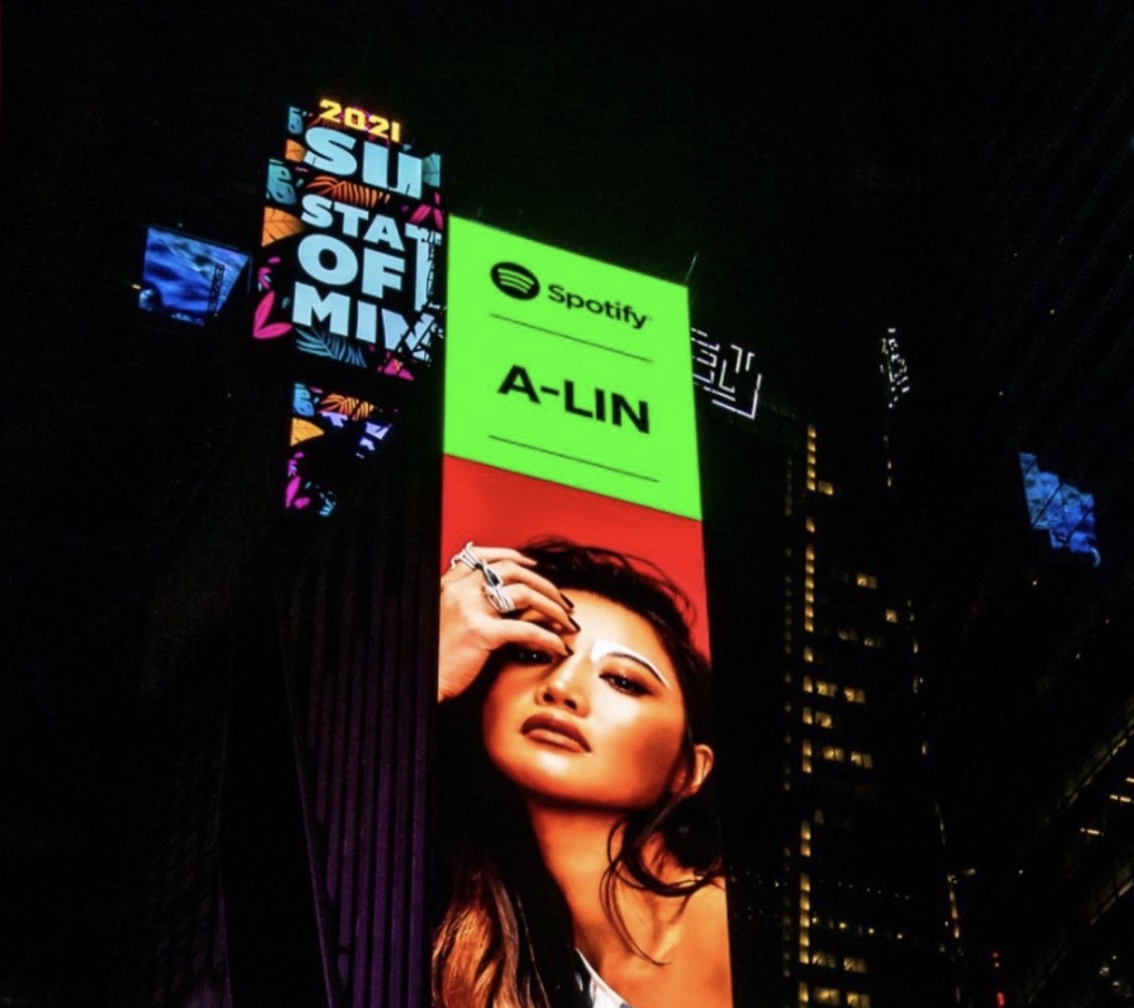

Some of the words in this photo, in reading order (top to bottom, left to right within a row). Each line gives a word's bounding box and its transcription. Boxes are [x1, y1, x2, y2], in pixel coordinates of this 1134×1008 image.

[319, 98, 400, 142] 2021
[297, 233, 406, 299] OF
[547, 283, 648, 330] Spotify
[497, 363, 650, 435] A-LIN
